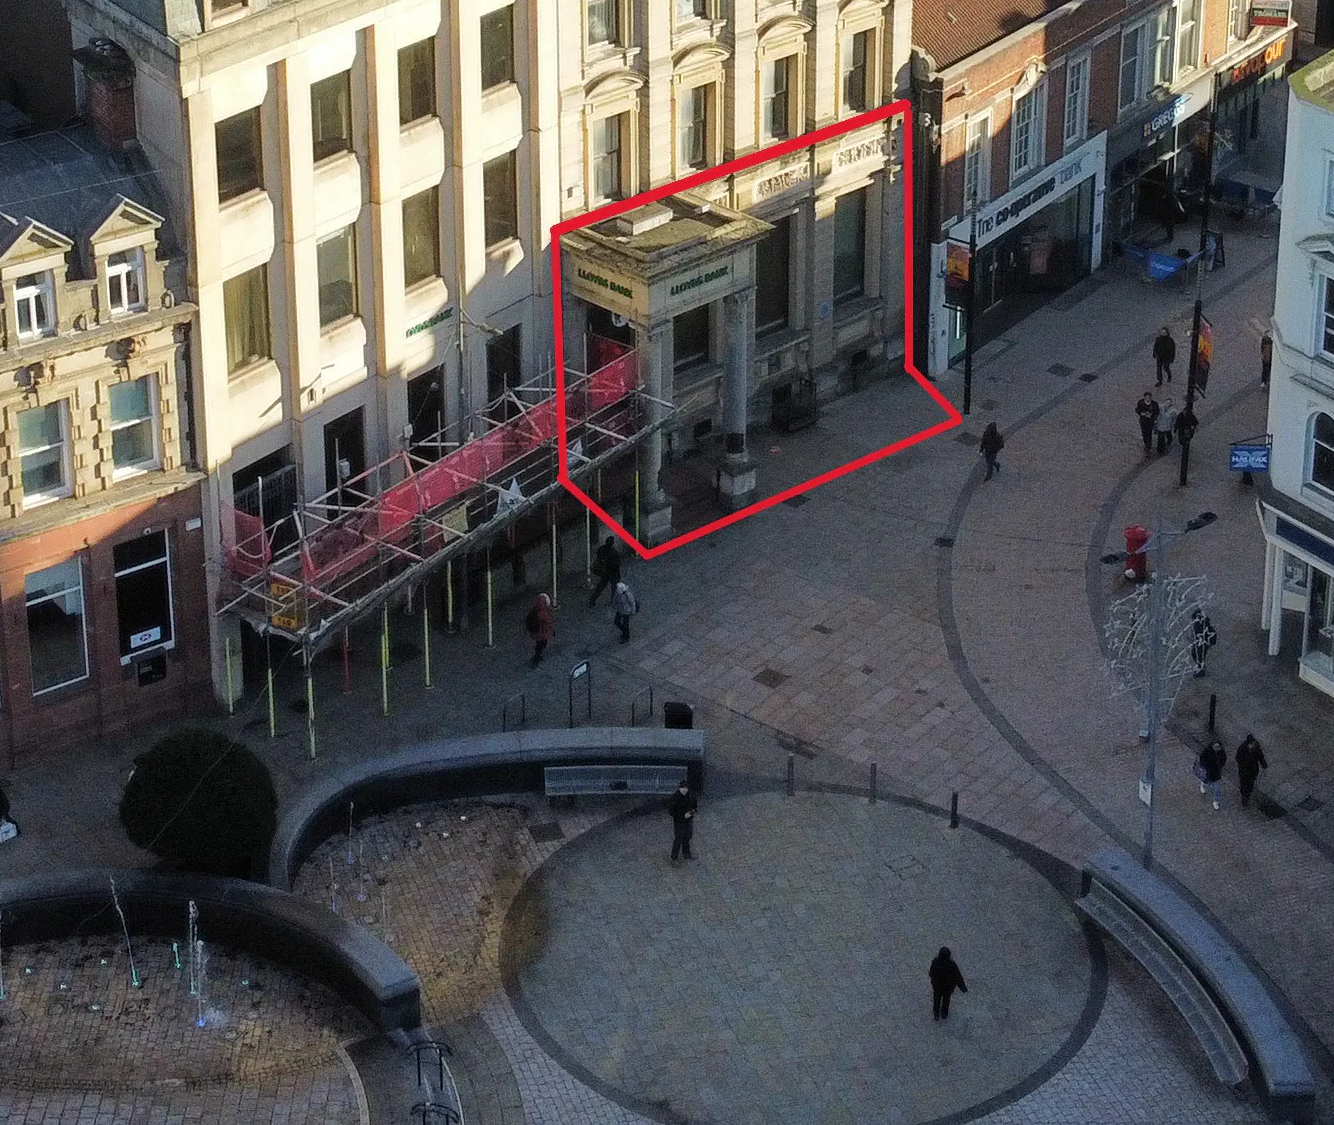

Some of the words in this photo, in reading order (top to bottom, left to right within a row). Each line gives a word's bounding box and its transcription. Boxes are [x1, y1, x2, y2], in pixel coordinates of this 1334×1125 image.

[995, 176, 1056, 228] co-operative
[577, 267, 609, 289] LLOYDS
[609, 281, 634, 299] BANK
[670, 275, 704, 297] LLOYDS
[704, 265, 730, 284] BANK
